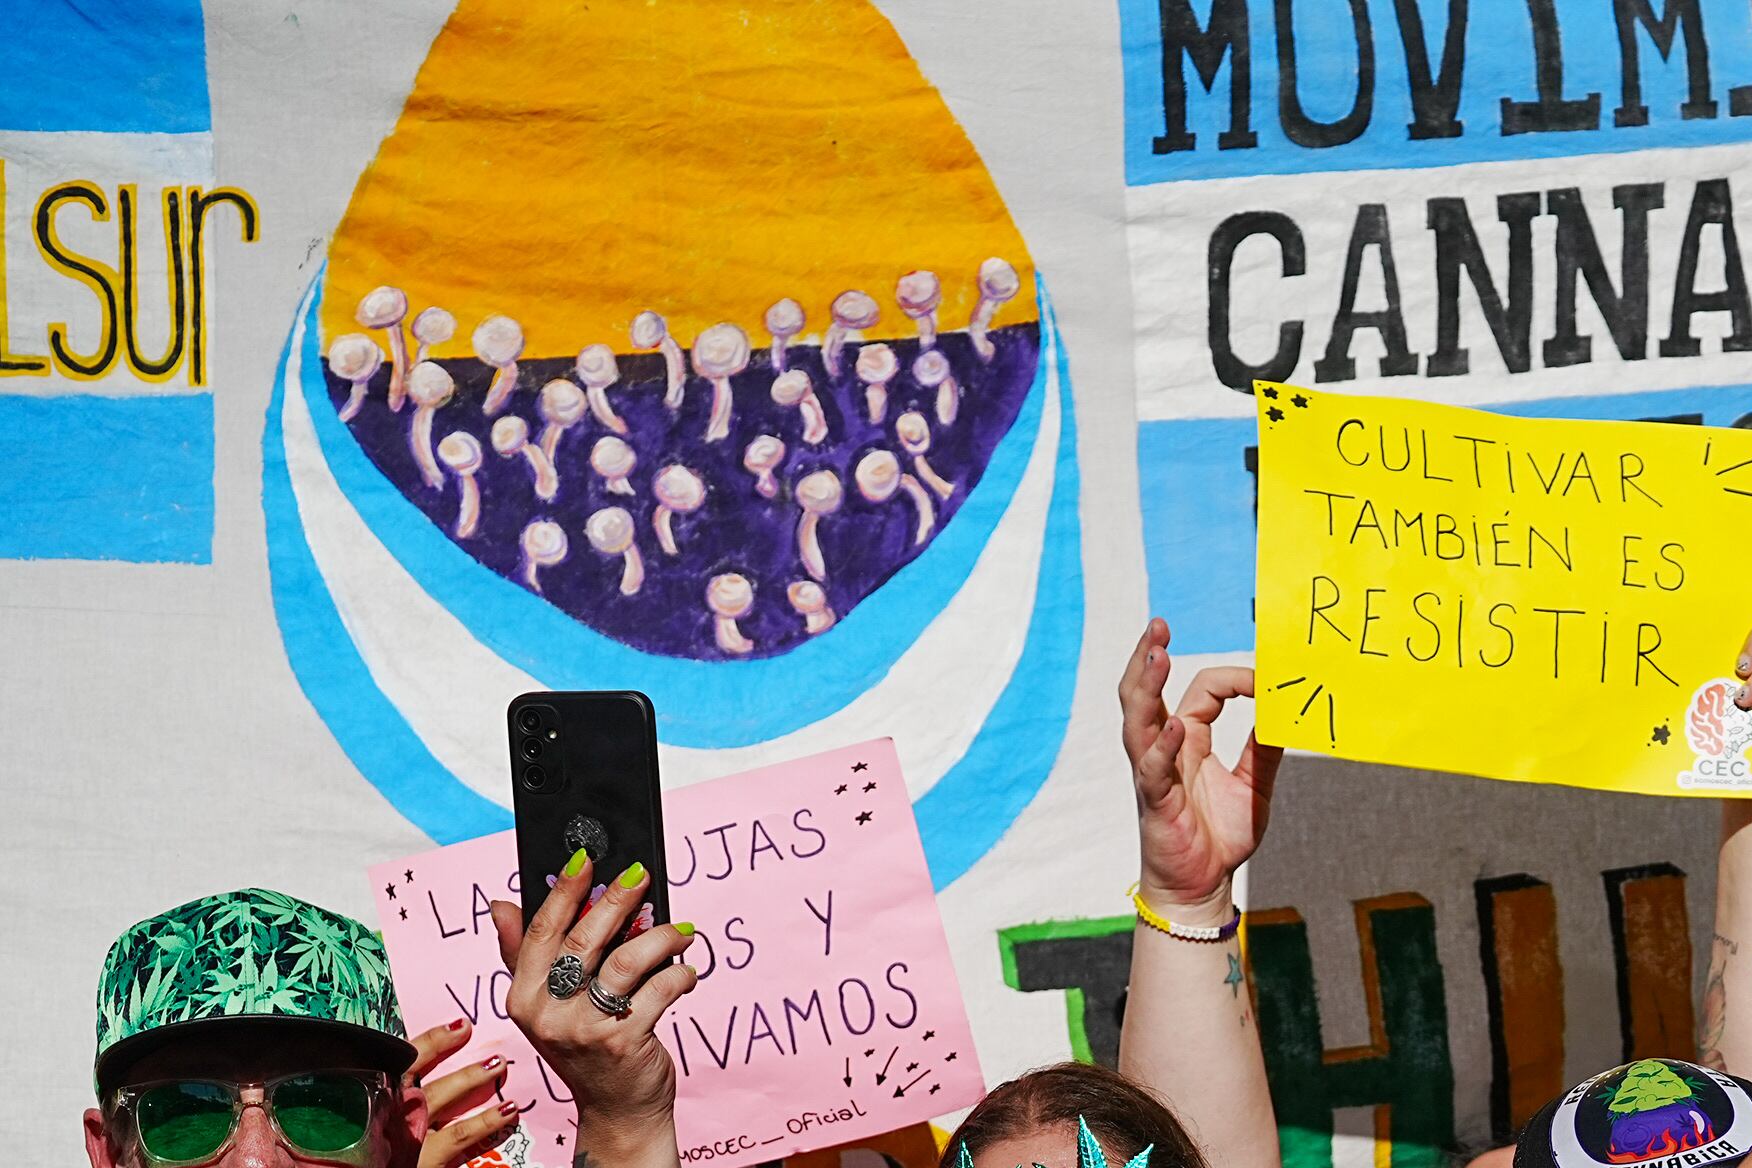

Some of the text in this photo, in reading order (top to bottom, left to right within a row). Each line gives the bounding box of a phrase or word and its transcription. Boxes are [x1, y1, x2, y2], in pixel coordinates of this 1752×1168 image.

[1622, 535, 1686, 592] ES
[1698, 759, 1745, 777] CEC
[805, 890, 833, 957] Y
